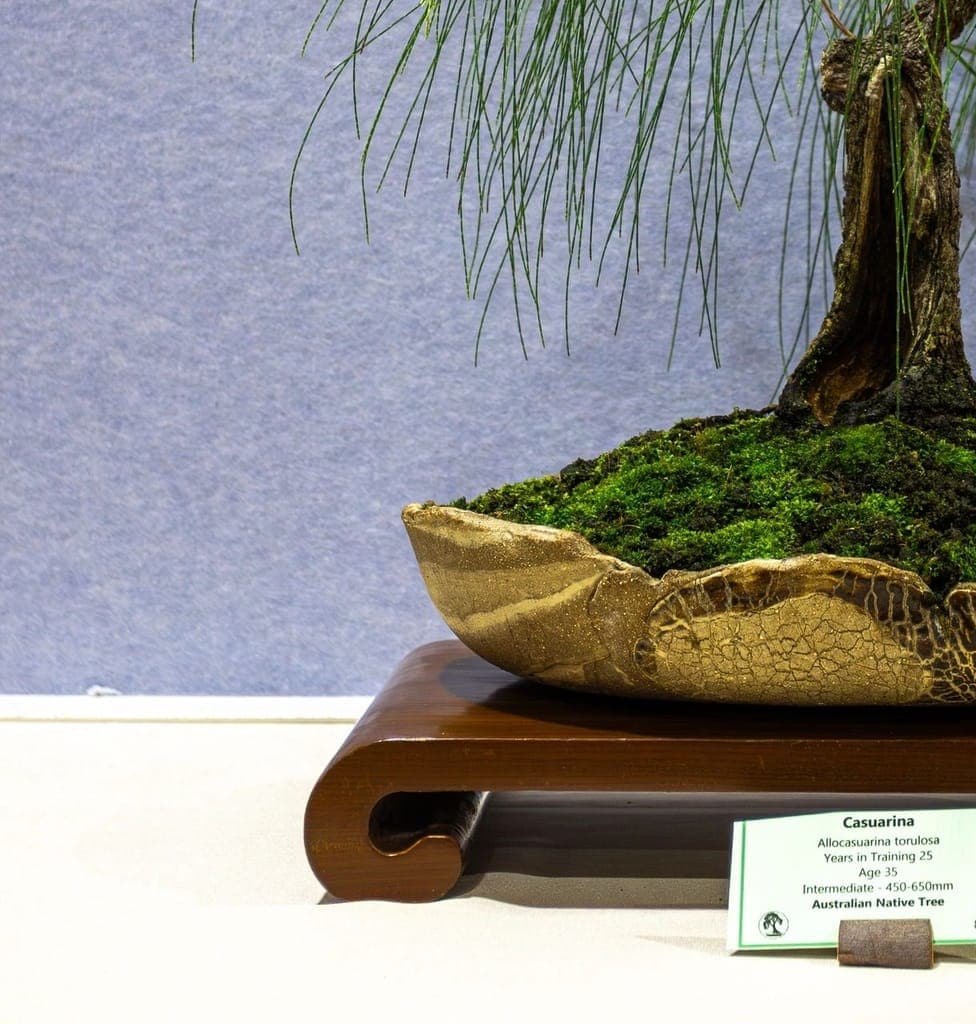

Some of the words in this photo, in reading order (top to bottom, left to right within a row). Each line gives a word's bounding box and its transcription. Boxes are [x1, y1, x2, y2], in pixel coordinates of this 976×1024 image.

[843, 815, 915, 829] Casuarina
[817, 836, 891, 849] Allocasuarina
[894, 835, 940, 847] torulosa
[823, 852, 854, 864] Years
[856, 852, 868, 863] in
[870, 851, 916, 863] Training
[919, 851, 933, 861] 25
[858, 867, 881, 880] Age
[884, 867, 898, 878] 35
[802, 883, 874, 895] Intermediate
[885, 881, 954, 892] 450-650mm
[811, 898, 873, 909] Australian
[876, 897, 915, 908] Native
[918, 896, 945, 907] Tree
